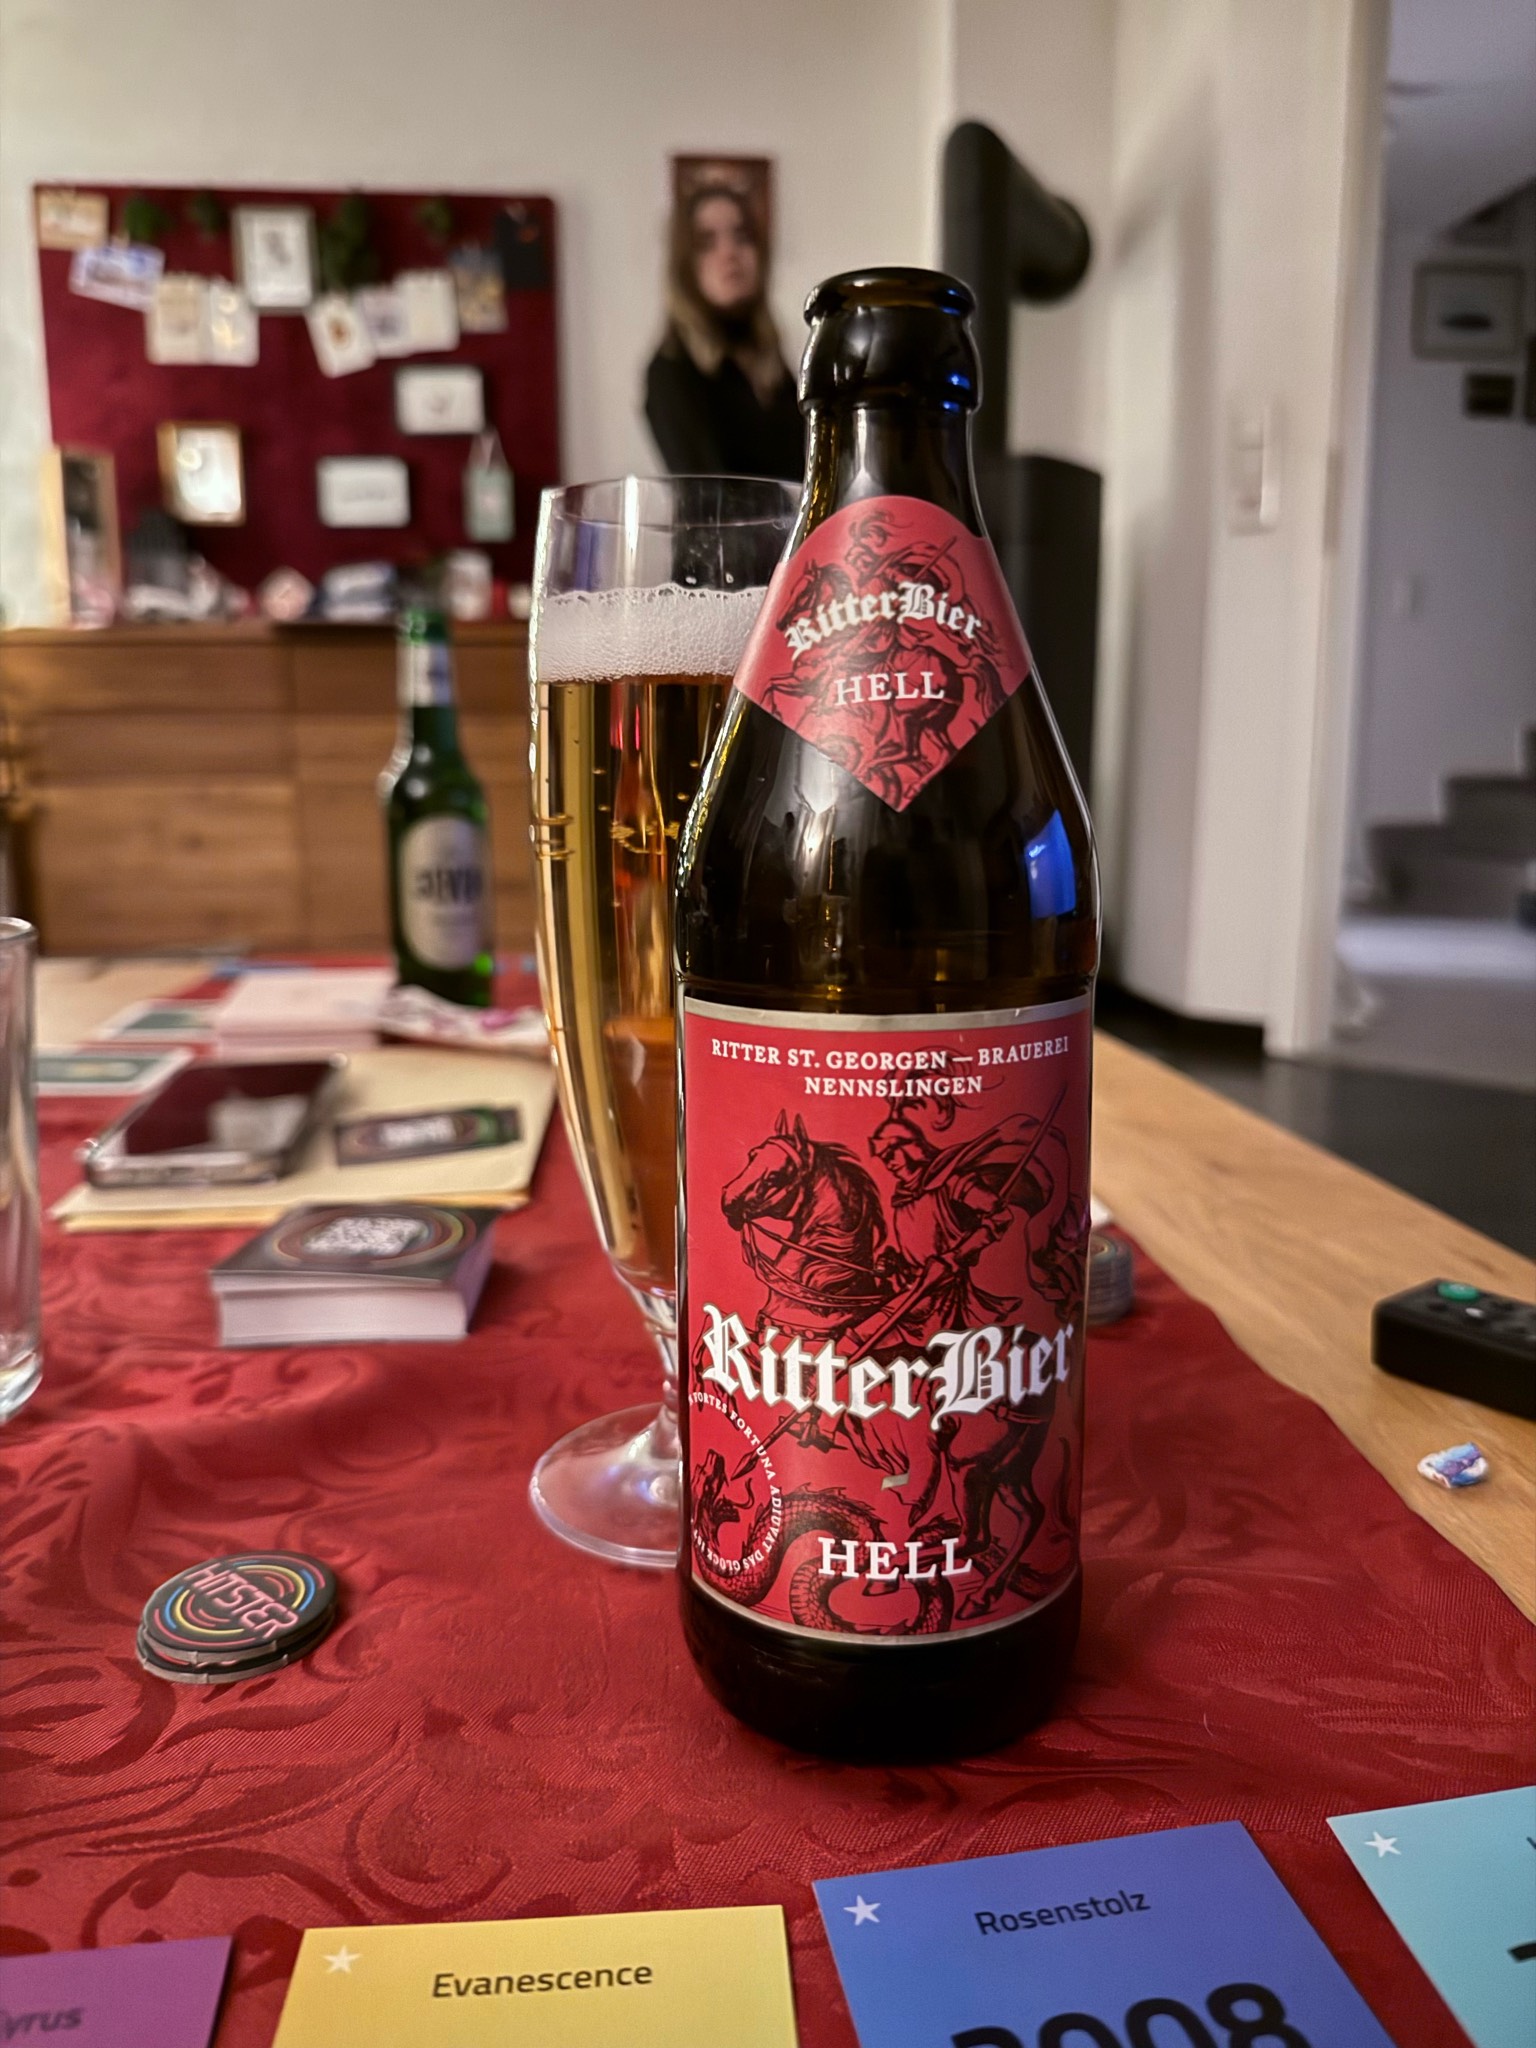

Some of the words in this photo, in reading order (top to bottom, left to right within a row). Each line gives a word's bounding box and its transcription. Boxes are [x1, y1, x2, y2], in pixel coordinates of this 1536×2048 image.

[833, 671, 946, 707] HELL
[711, 1039, 781, 1064] RITTER
[787, 1050, 821, 1069] ST.
[826, 1051, 947, 1070] GEORGEN
[978, 1036, 1069, 1066] BRAUEREI
[805, 1077, 982, 1097] NENNSLINGEN
[693, 1391, 728, 1414] FORTES
[729, 1410, 777, 1480] FORTUNA
[761, 1485, 783, 1554] ADIUVAT
[742, 1549, 765, 1571] DAS
[817, 1536, 974, 1581] HELL
[184, 1563, 299, 1638] HITSTER
[975, 1890, 1150, 1935] Rosenstolz
[432, 1963, 654, 1998] Evanescence
[0, 2006, 84, 2041] yrus
